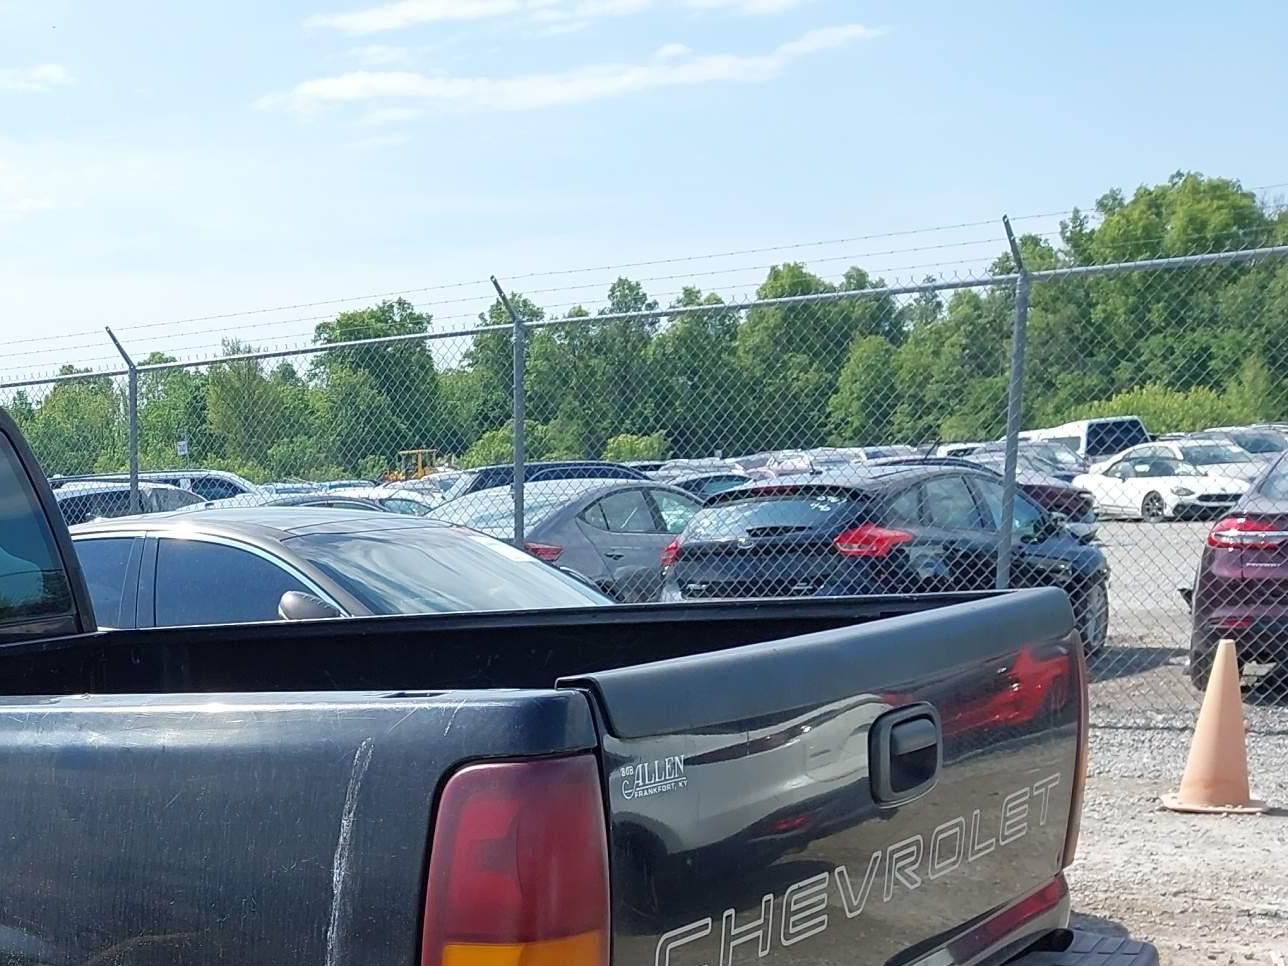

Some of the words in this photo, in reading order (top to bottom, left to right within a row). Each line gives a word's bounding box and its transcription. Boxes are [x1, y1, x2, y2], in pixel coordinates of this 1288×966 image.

[620, 765, 634, 777] BOB
[625, 754, 685, 796] ALLEN
[634, 782, 677, 799] FRANKFORT,
[678, 780, 688, 789] KY
